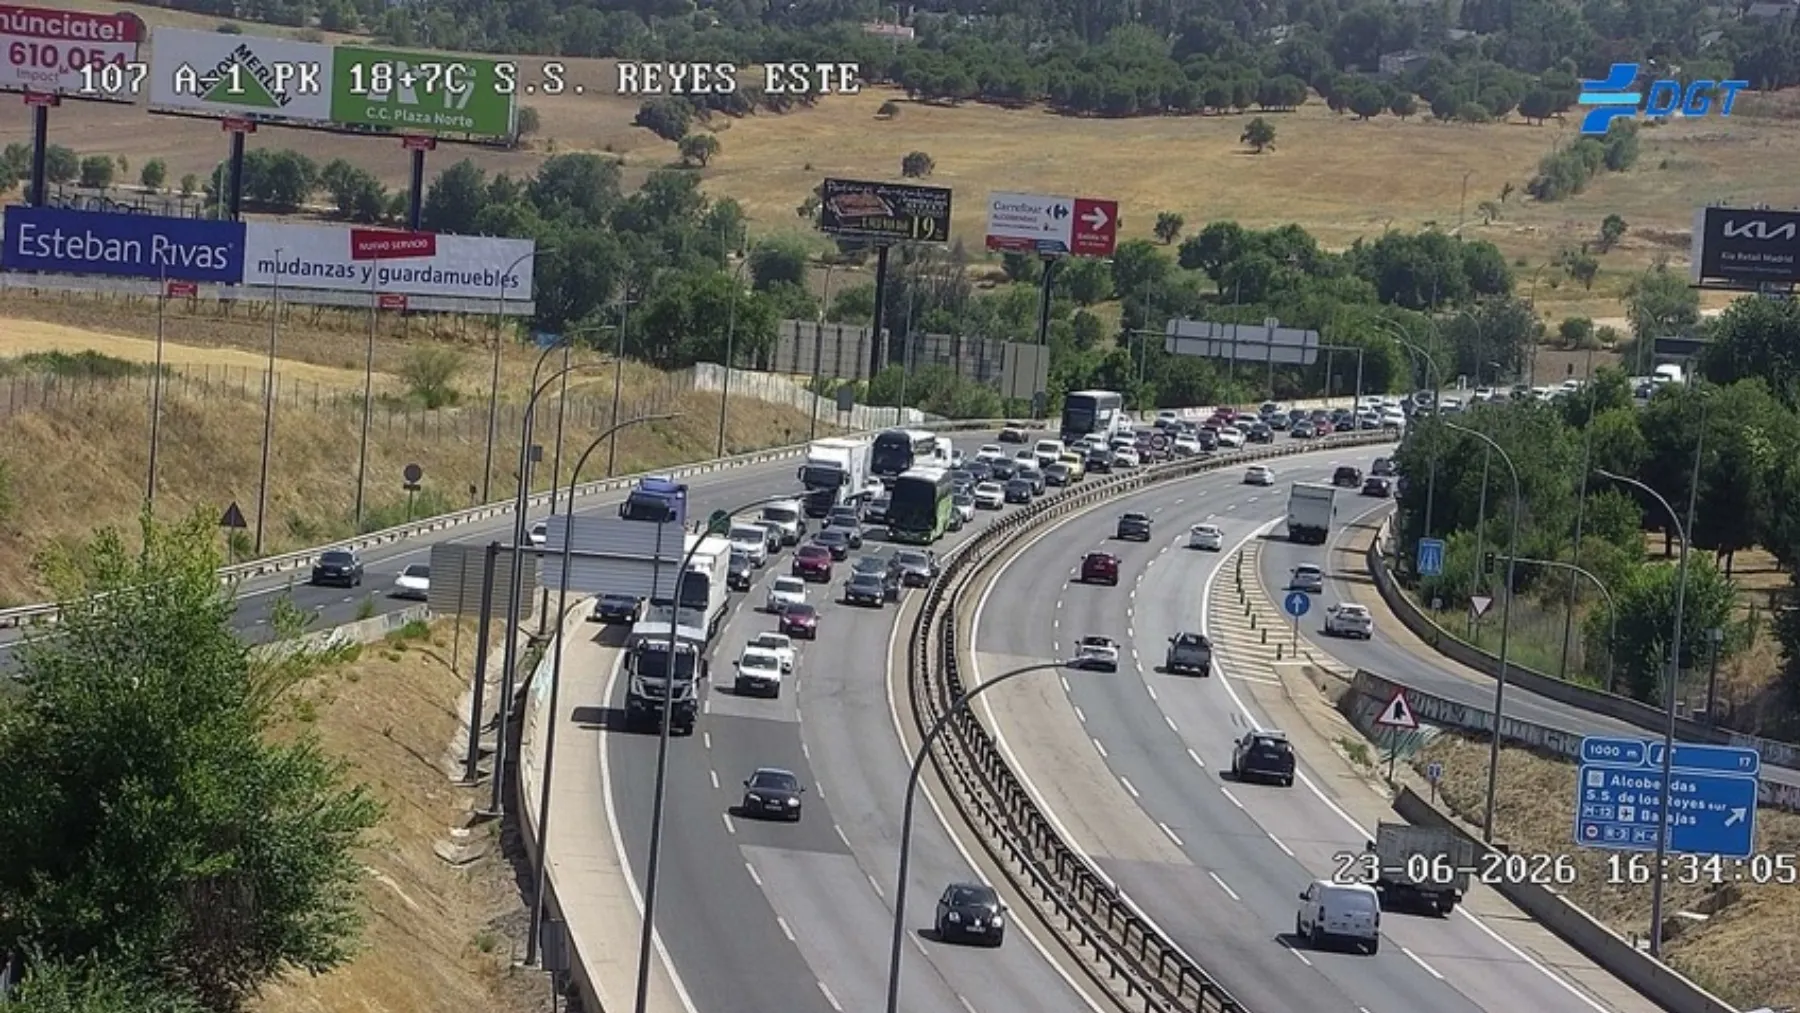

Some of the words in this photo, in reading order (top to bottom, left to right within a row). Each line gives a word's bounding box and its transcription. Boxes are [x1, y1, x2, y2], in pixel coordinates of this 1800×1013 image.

[9, 41, 59, 68] 610
[234, 43, 293, 107] MERLN
[365, 106, 392, 121] C.C.
[394, 108, 431, 125] Plaza
[433, 111, 474, 128] Norte
[18, 223, 141, 264] Esteban
[150, 234, 228, 270] Rivas
[258, 256, 356, 279] mudanzas
[360, 265, 372, 284] y
[378, 265, 520, 289] guardamuebles
[1590, 744, 1620, 757] 1000
[1626, 749, 1638, 758] m
[1610, 774, 1697, 793] Alcobedas
[1618, 791, 1635, 804] de
[1639, 793, 1660, 806] los
[1641, 810, 1697, 826] Baajas
